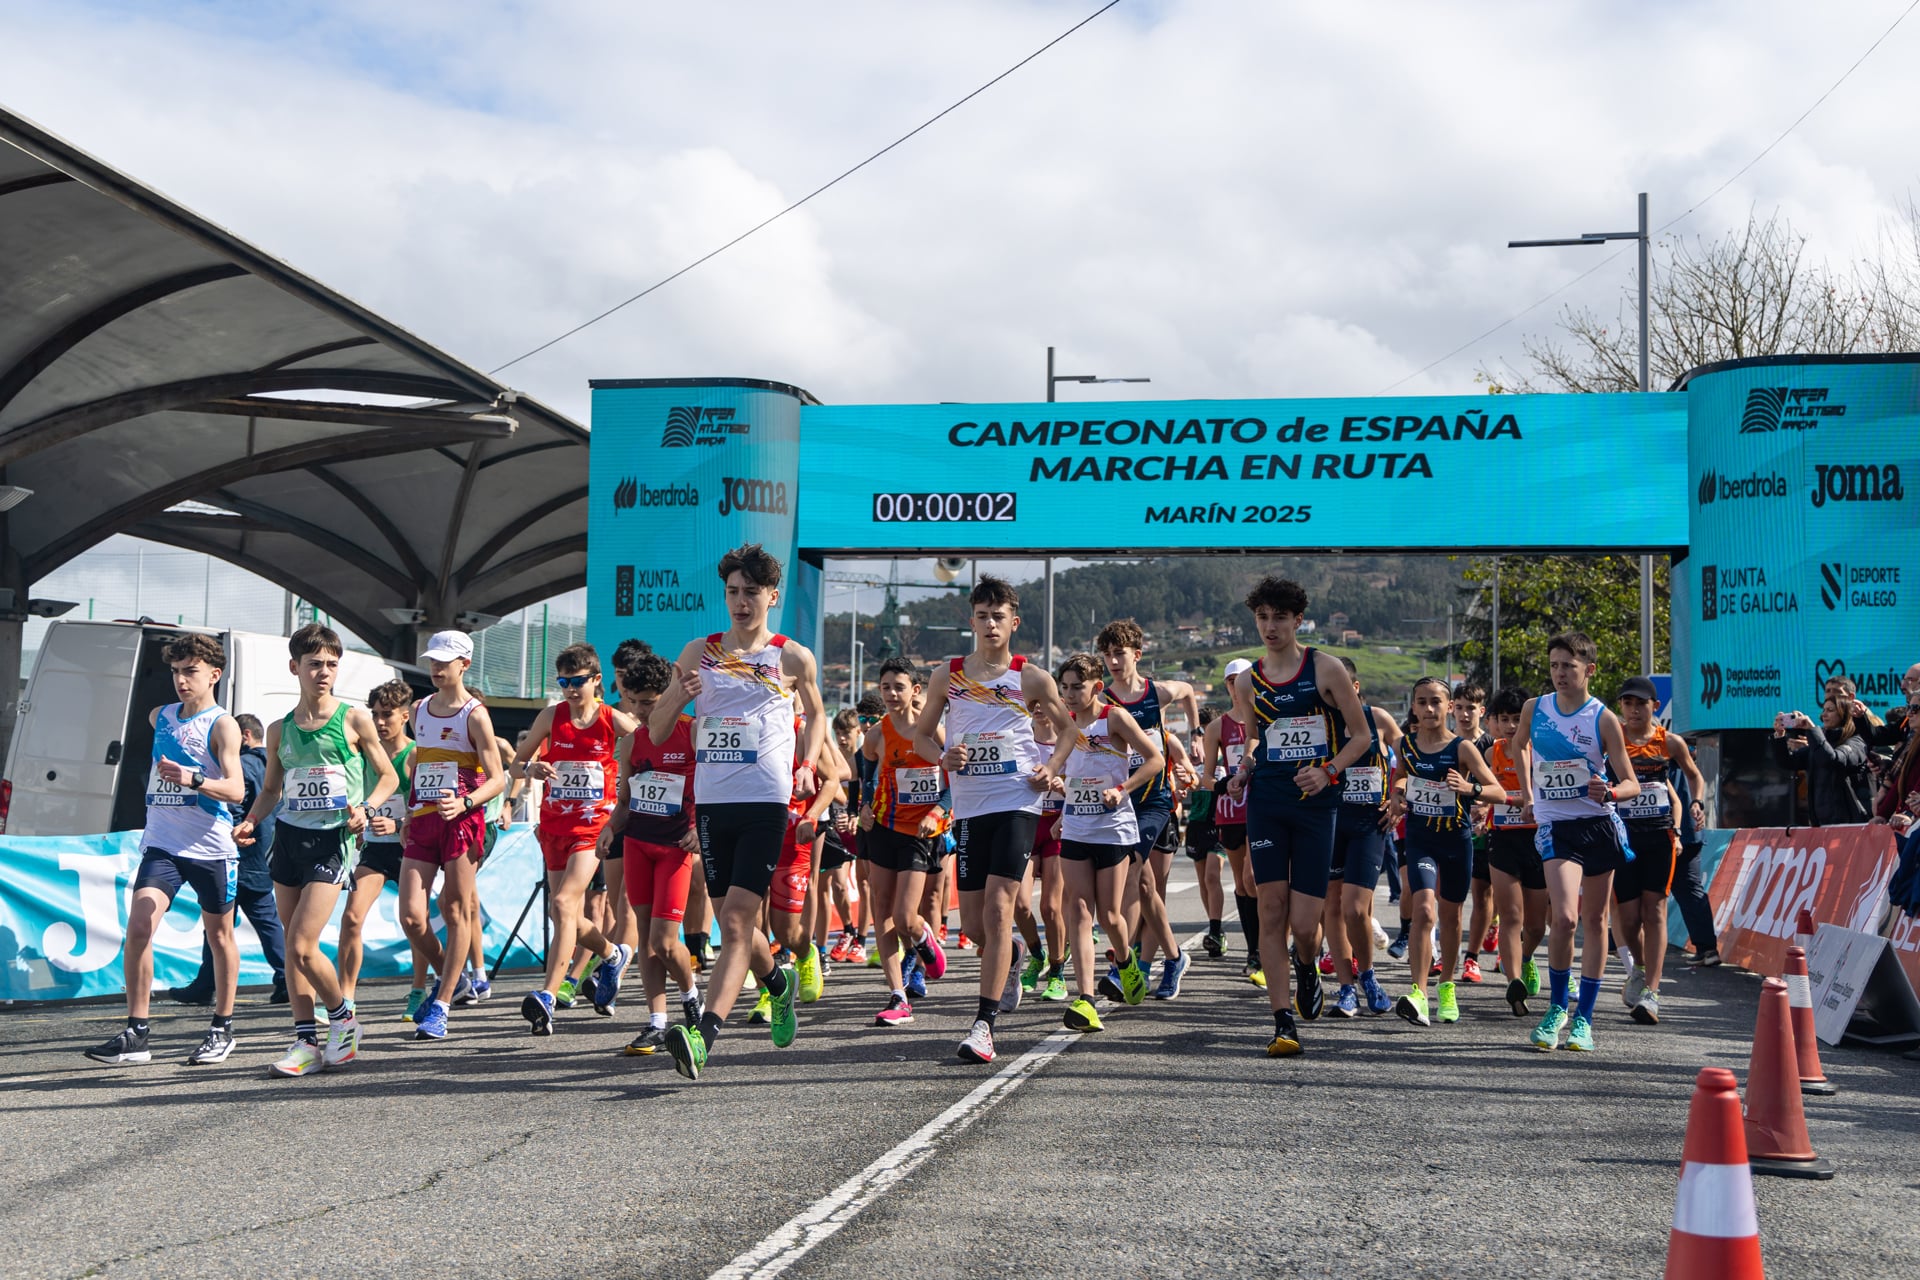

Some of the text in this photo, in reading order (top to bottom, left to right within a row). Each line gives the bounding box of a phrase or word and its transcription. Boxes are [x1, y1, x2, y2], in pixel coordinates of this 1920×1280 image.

[948, 409, 1523, 447] CAMPEONATO de ESPAÑA
[1029, 453, 1434, 483] MARCHA EN RUTA
[1719, 471, 1787, 500] Iberdrola
[640, 482, 699, 507] Iberdrola
[877, 493, 1013, 521] 00:00:02
[1144, 502, 1312, 524] MARÍN 2025
[639, 569, 680, 588] XUNTA
[1720, 567, 1767, 589] XUNTA
[1851, 567, 1900, 584] DEPORTE
[638, 593, 705, 612] DE GALICIA
[1720, 592, 1799, 614] DE GALICIA
[1851, 590, 1897, 607] GALEGO
[1726, 665, 1781, 684] Deputación
[1850, 667, 1905, 695] MARÍN
[1726, 683, 1781, 698] Pontevedra
[707, 732, 741, 748] 236
[1279, 731, 1312, 747] 242
[705, 751, 744, 763] Joma
[968, 747, 1000, 762] 228
[1279, 747, 1317, 760] Joma
[967, 762, 1005, 776] Joma
[156, 779, 182, 793] 208
[420, 774, 444, 788] 227
[562, 774, 590, 787] 247
[910, 779, 938, 793] 205
[1344, 779, 1370, 792] 238
[1544, 773, 1575, 788] 210
[297, 781, 330, 797] 206
[560, 788, 593, 799] Joma
[639, 784, 667, 801] 187
[1543, 787, 1581, 800] Joma
[151, 795, 185, 805] Joma
[296, 798, 336, 811] Joma
[909, 793, 940, 804] Joma
[1074, 790, 1100, 804] 243
[1414, 790, 1441, 805] 214
[1631, 793, 1657, 807] 320
[636, 800, 668, 814] Joma
[1073, 803, 1105, 815] Joma
[1628, 807, 1660, 817] Joma
[959, 857, 969, 878] León
